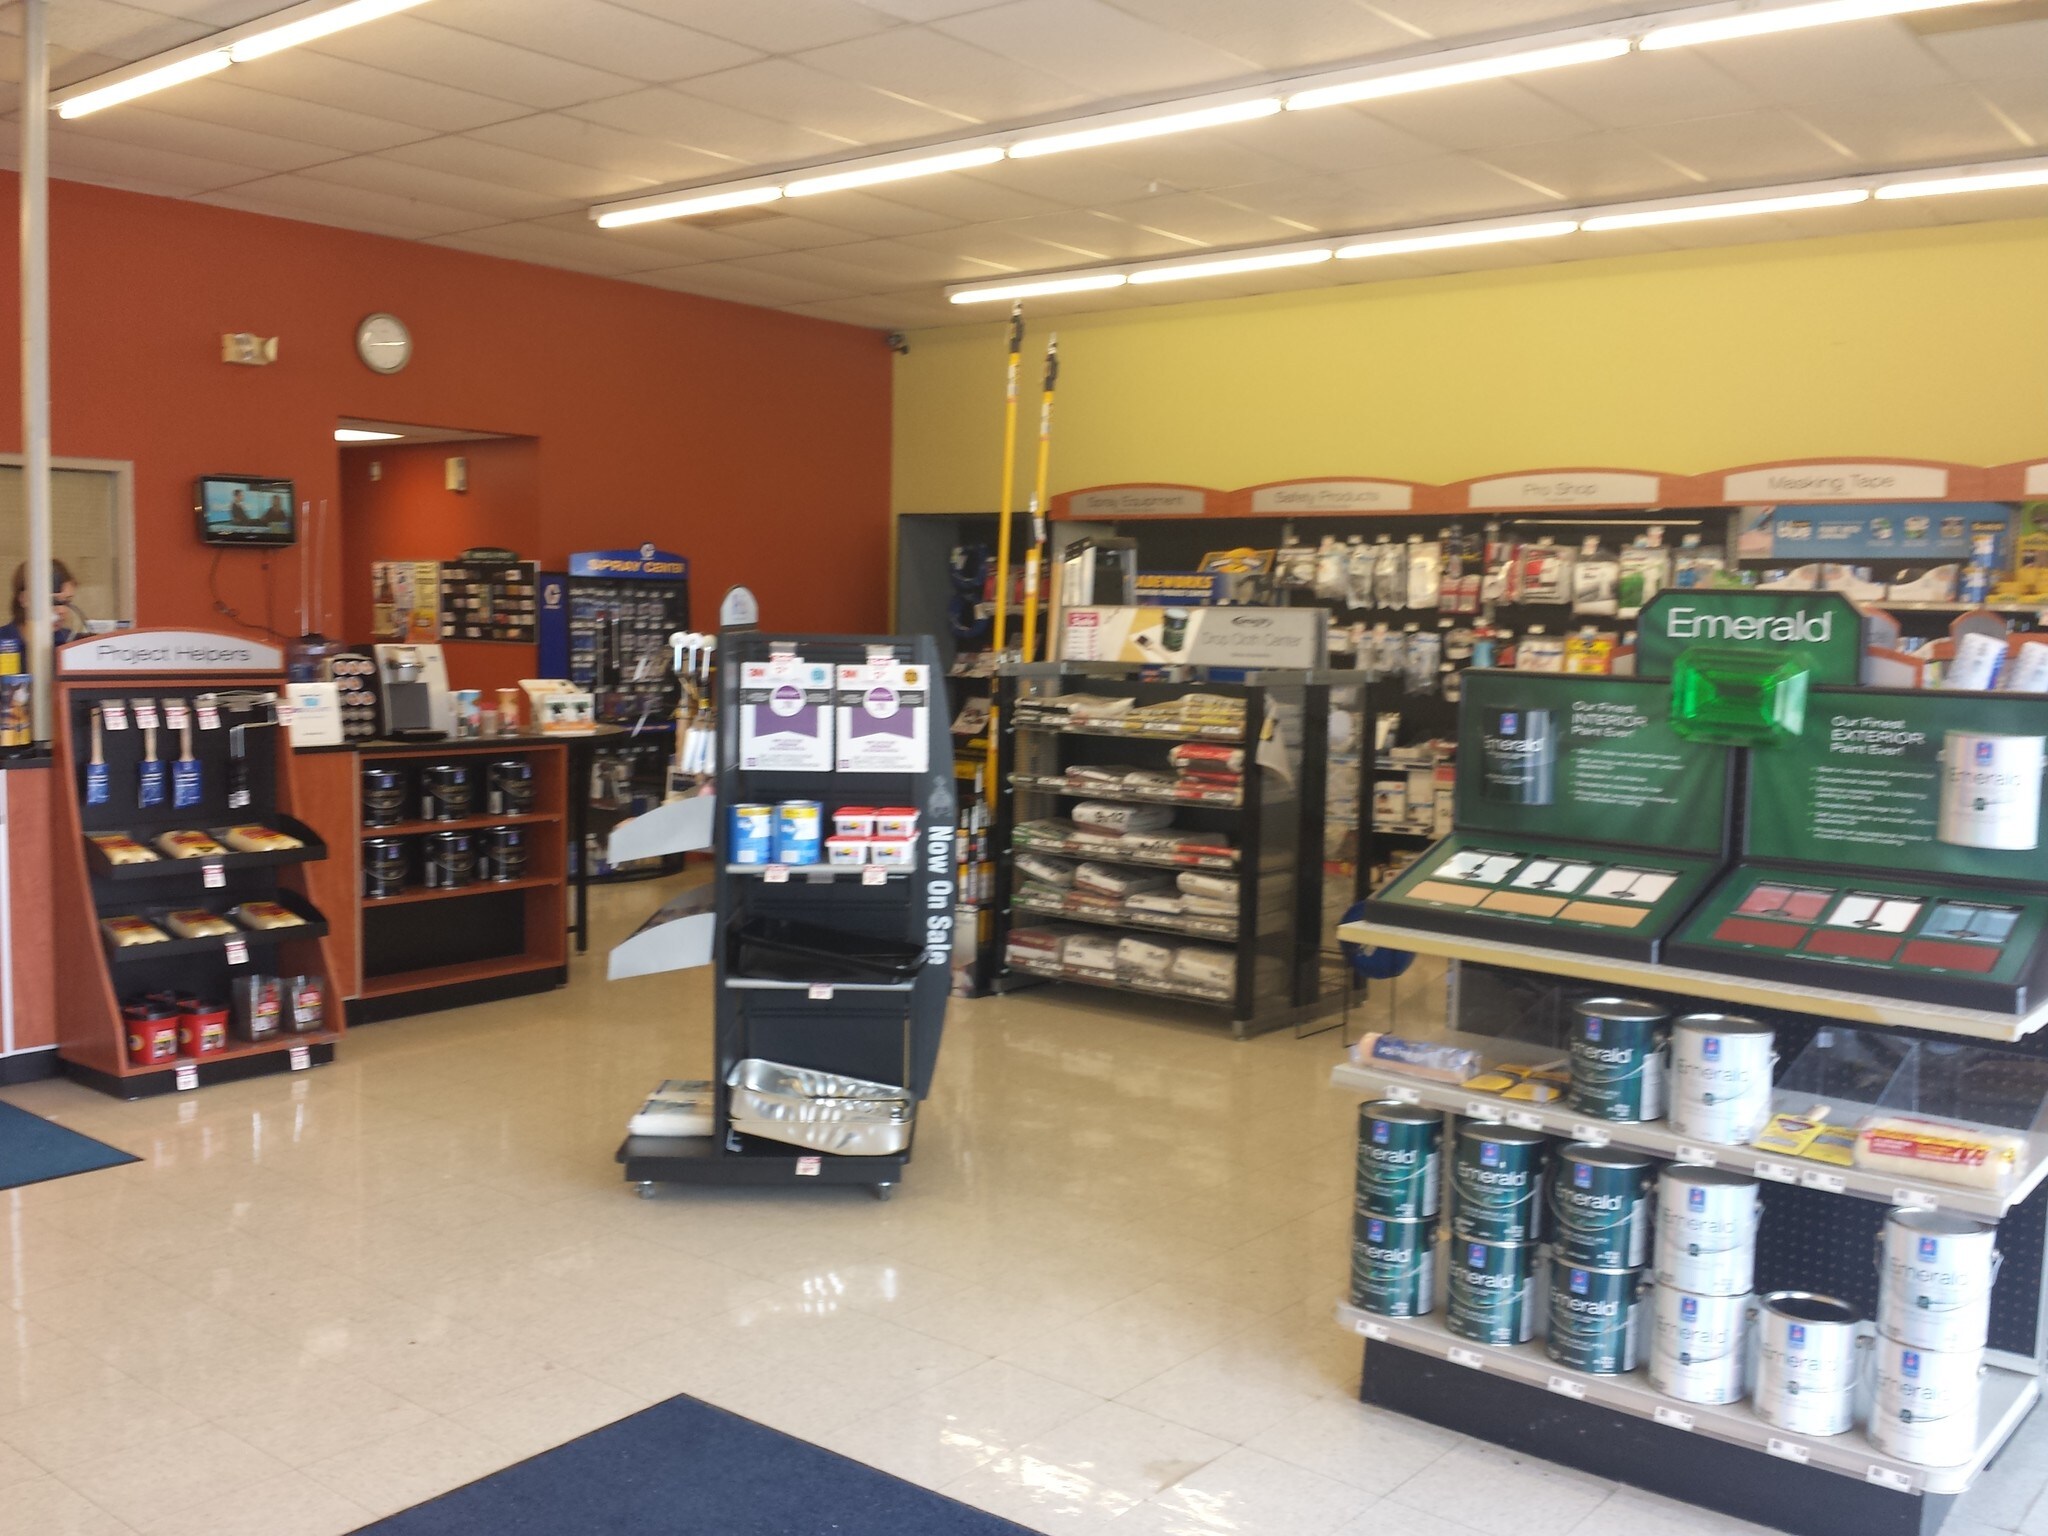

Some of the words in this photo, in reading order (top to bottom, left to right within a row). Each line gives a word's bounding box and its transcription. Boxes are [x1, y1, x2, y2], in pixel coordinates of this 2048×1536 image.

[1768, 475, 1844, 492] Masking
[1850, 474, 1895, 490] Tape
[1667, 607, 1833, 643] Emerald
[96, 645, 169, 664] Project
[175, 645, 251, 664] Helpers
[1571, 713, 1648, 728] INTERIOR
[1830, 728, 1926, 744] EXTERIOR
[927, 825, 954, 874] Now
[927, 880, 953, 909] On
[926, 915, 953, 965] Sale
[1458, 1161, 1529, 1186] Emerald
[1555, 1182, 1624, 1210] Emerald
[1763, 1342, 1838, 1372] Emera
